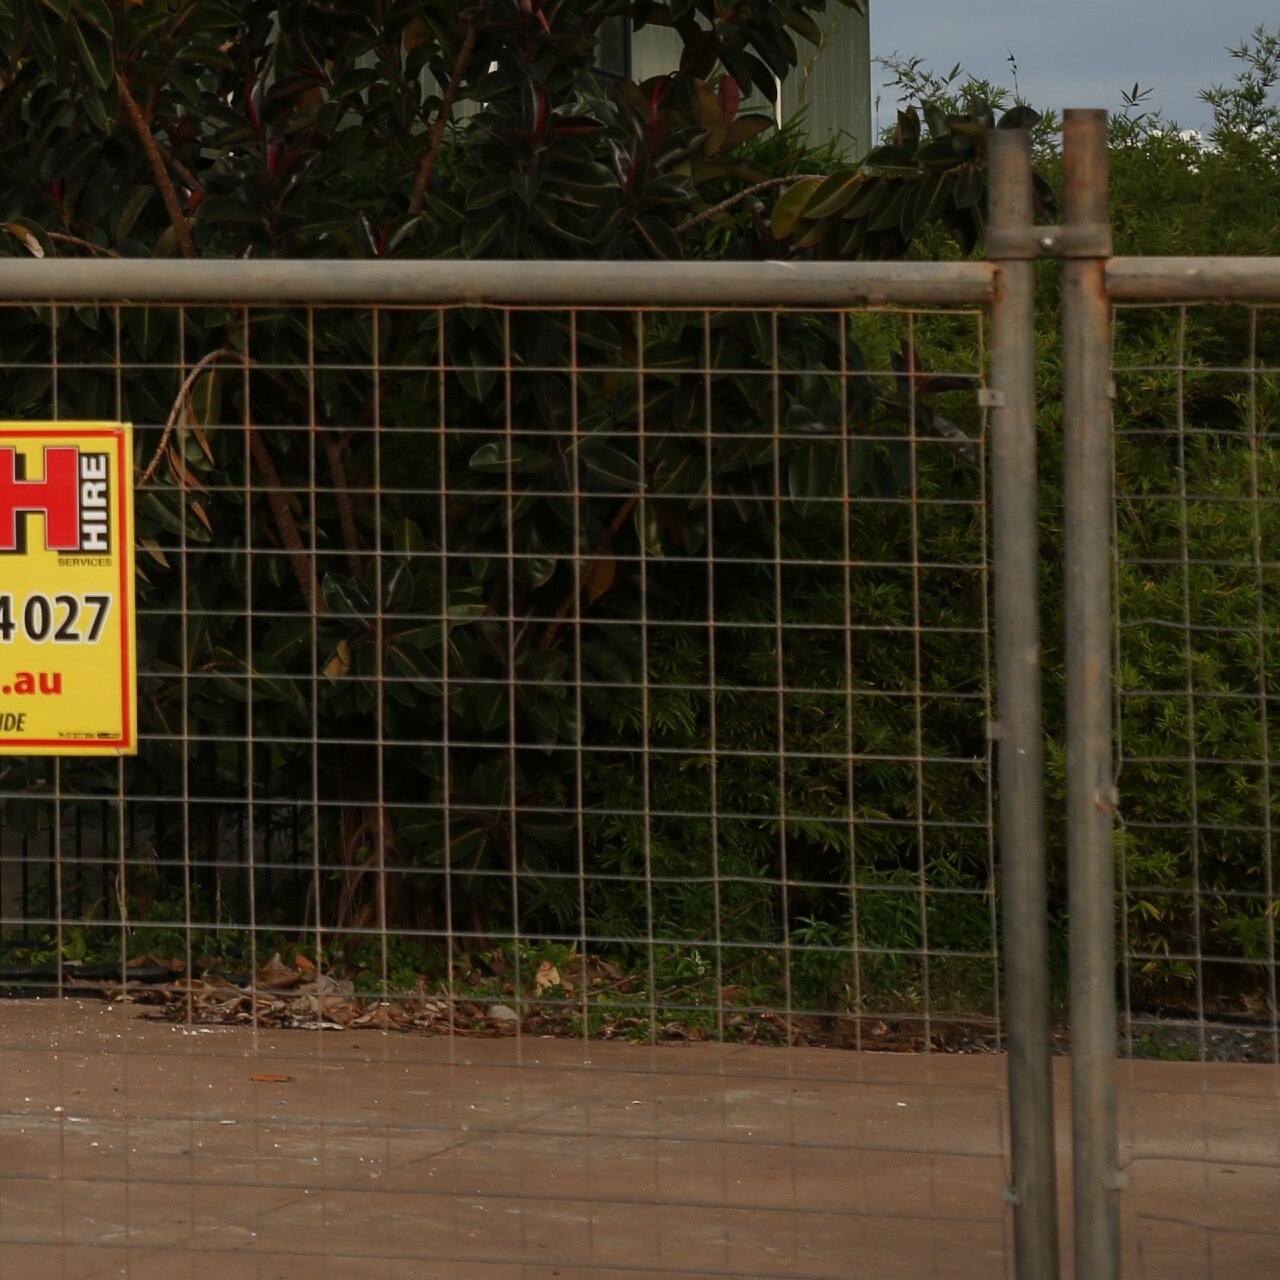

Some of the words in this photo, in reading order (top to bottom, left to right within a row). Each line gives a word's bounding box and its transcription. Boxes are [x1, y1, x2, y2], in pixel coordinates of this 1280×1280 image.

[81, 454, 108, 550] HIRE
[58, 558, 112, 567] SERVICES
[23, 593, 111, 642] 027
